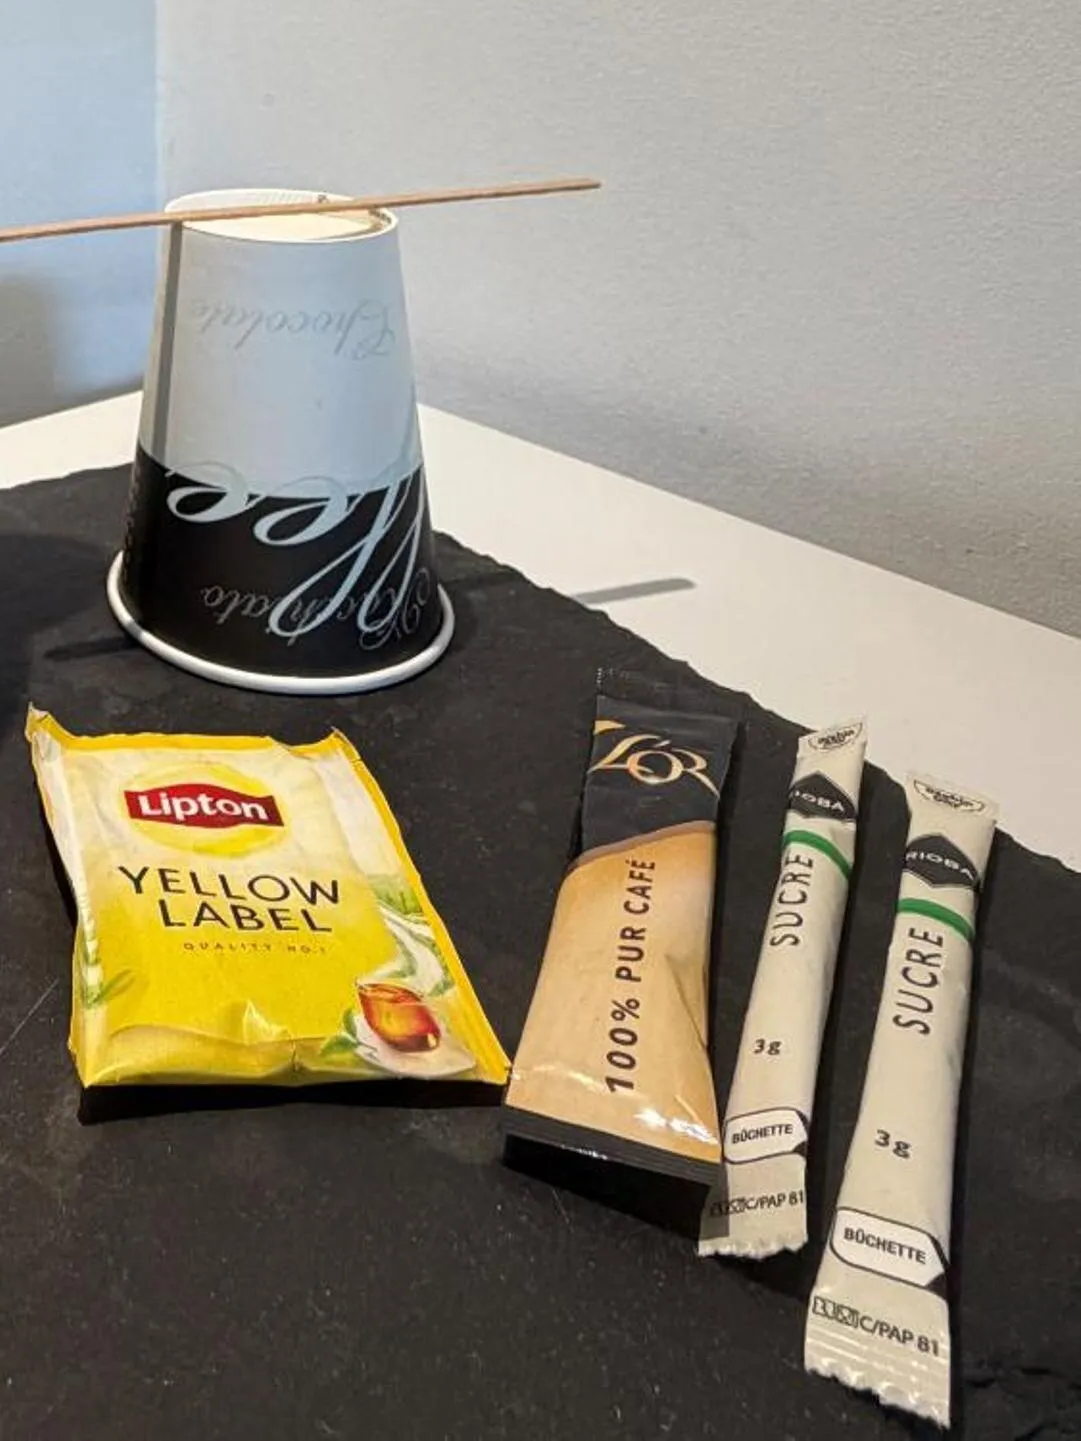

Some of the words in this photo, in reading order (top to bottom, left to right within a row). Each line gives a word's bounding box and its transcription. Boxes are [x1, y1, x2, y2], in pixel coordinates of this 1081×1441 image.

[191, 298, 396, 361] Chocolate
[164, 405, 426, 637] ffee
[138, 792, 269, 820] Lipton
[792, 790, 845, 812] IOBA
[118, 865, 339, 906] YELLOW
[905, 851, 974, 880] RIOBA
[623, 859, 656, 915] CAFÉ
[769, 853, 813, 947] SUCRE
[159, 898, 332, 932] LABEL
[184, 941, 271, 952] QUALITY
[615, 926, 647, 982] PUR
[892, 927, 944, 1035] SUCRE
[606, 997, 641, 1094] 100%
[731, 1123, 794, 1144] BÛCHETTE
[788, 1190, 804, 1205] 81
[843, 1226, 927, 1266] BÛCHETTE
[916, 1336, 940, 1357] 81
